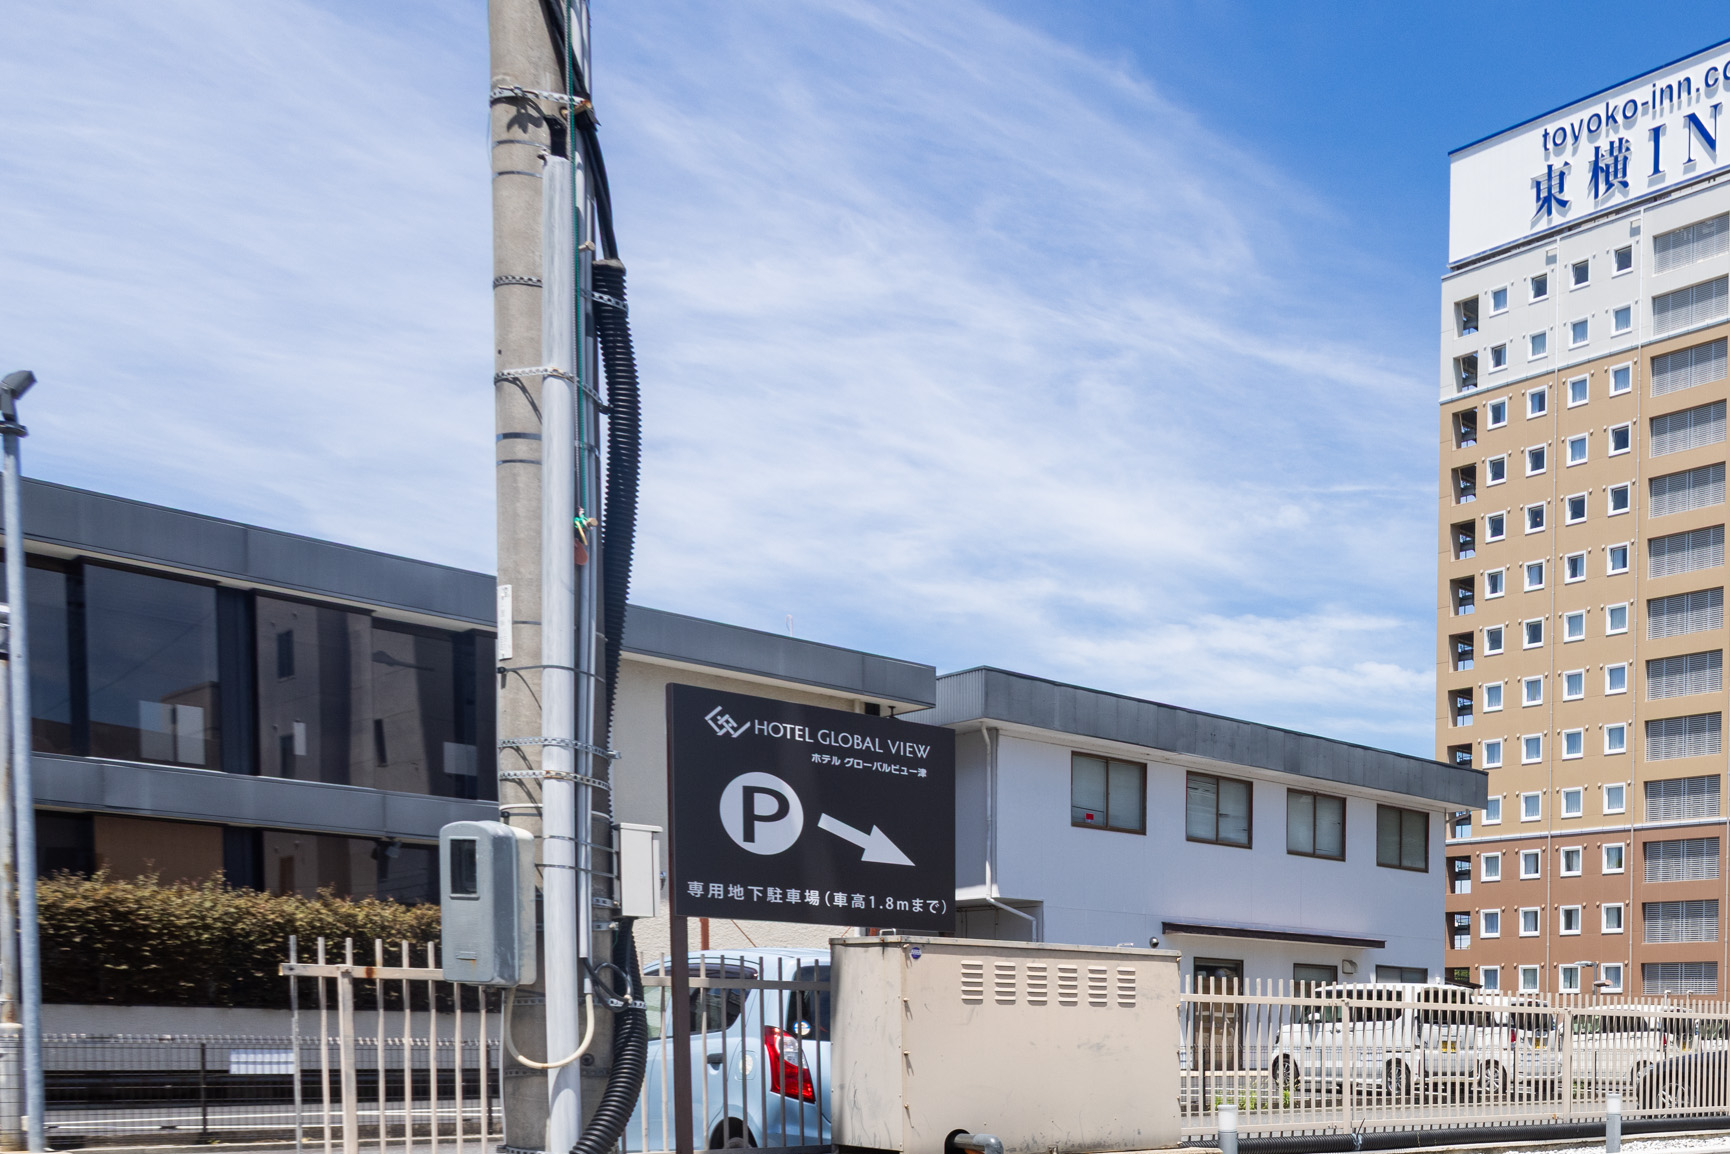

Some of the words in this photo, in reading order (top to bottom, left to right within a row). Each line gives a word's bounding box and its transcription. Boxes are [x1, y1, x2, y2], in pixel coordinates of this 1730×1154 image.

[754, 719, 814, 743] HOTEL
[817, 729, 884, 753] GLOBAL
[887, 740, 931, 760] VIEW
[811, 753, 841, 767] ホテル
[843, 757, 928, 778] グローバルビュー津
[742, 785, 791, 844] P
